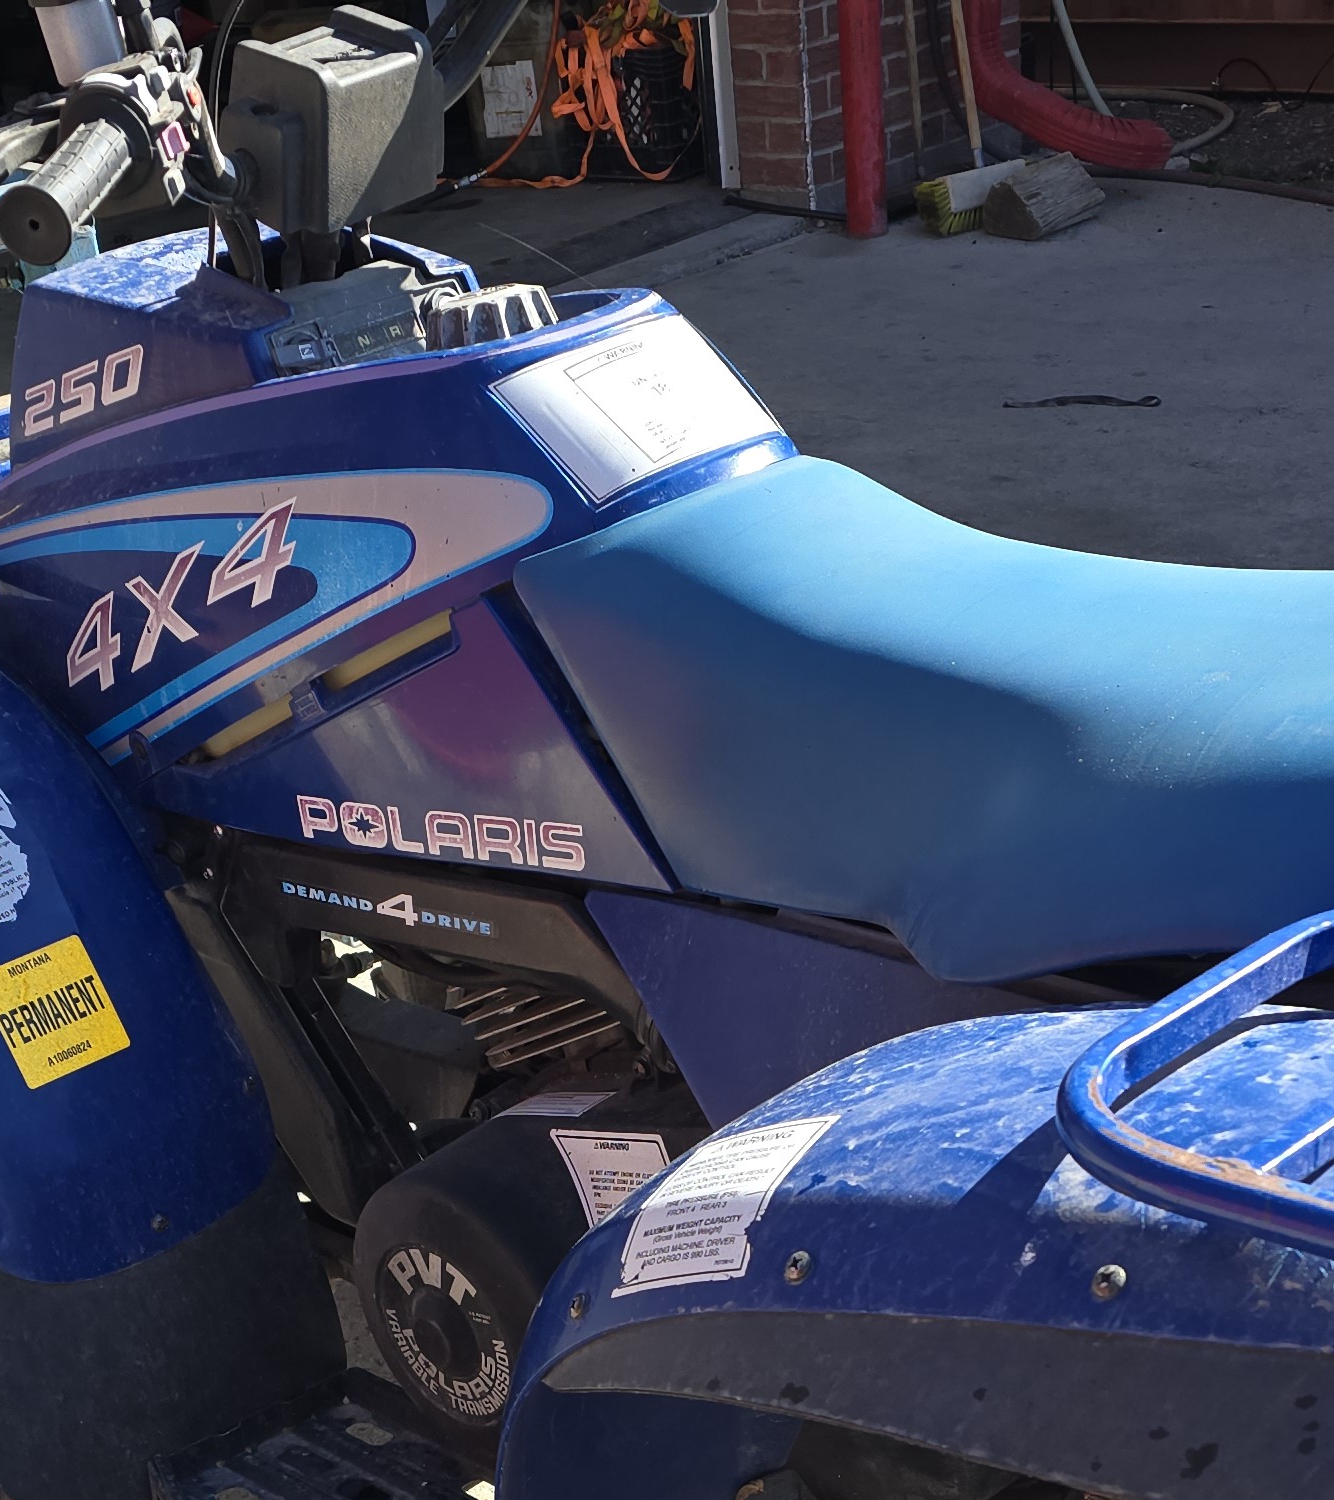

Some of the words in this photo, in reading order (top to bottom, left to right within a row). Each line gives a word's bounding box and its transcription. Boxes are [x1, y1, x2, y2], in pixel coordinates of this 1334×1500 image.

[22, 344, 144, 437] 250
[67, 497, 298, 692] 4X4
[296, 794, 585, 871] POLARIS
[1, 874, 23, 887] PUBLIC
[281, 881, 374, 912] DEMAND
[376, 893, 419, 927] 4
[421, 911, 492, 936] DRIVE
[7, 952, 52, 979] MONTANA
[47, 1040, 93, 1068] A10060824
[599, 1141, 629, 1150] WARNING
[726, 1130, 794, 1148] WARNING
[666, 1206, 689, 1216] FRONT
[699, 1201, 721, 1210] REAR
[643, 1224, 674, 1236] MAXIMUM
[675, 1219, 705, 1229] WEIGHT
[702, 1214, 741, 1225] CAPACITY
[635, 1245, 669, 1258] INCLUDING
[706, 1234, 735, 1247] DRIVER
[656, 1253, 681, 1264] CARGO
[681, 1251, 689, 1259] IS
[388, 1249, 477, 1306] PVT
[386, 1309, 439, 1395] VARIABLE
[402, 1329, 496, 1399] POLARIS
[449, 1339, 510, 1416] TRANSMISSION
